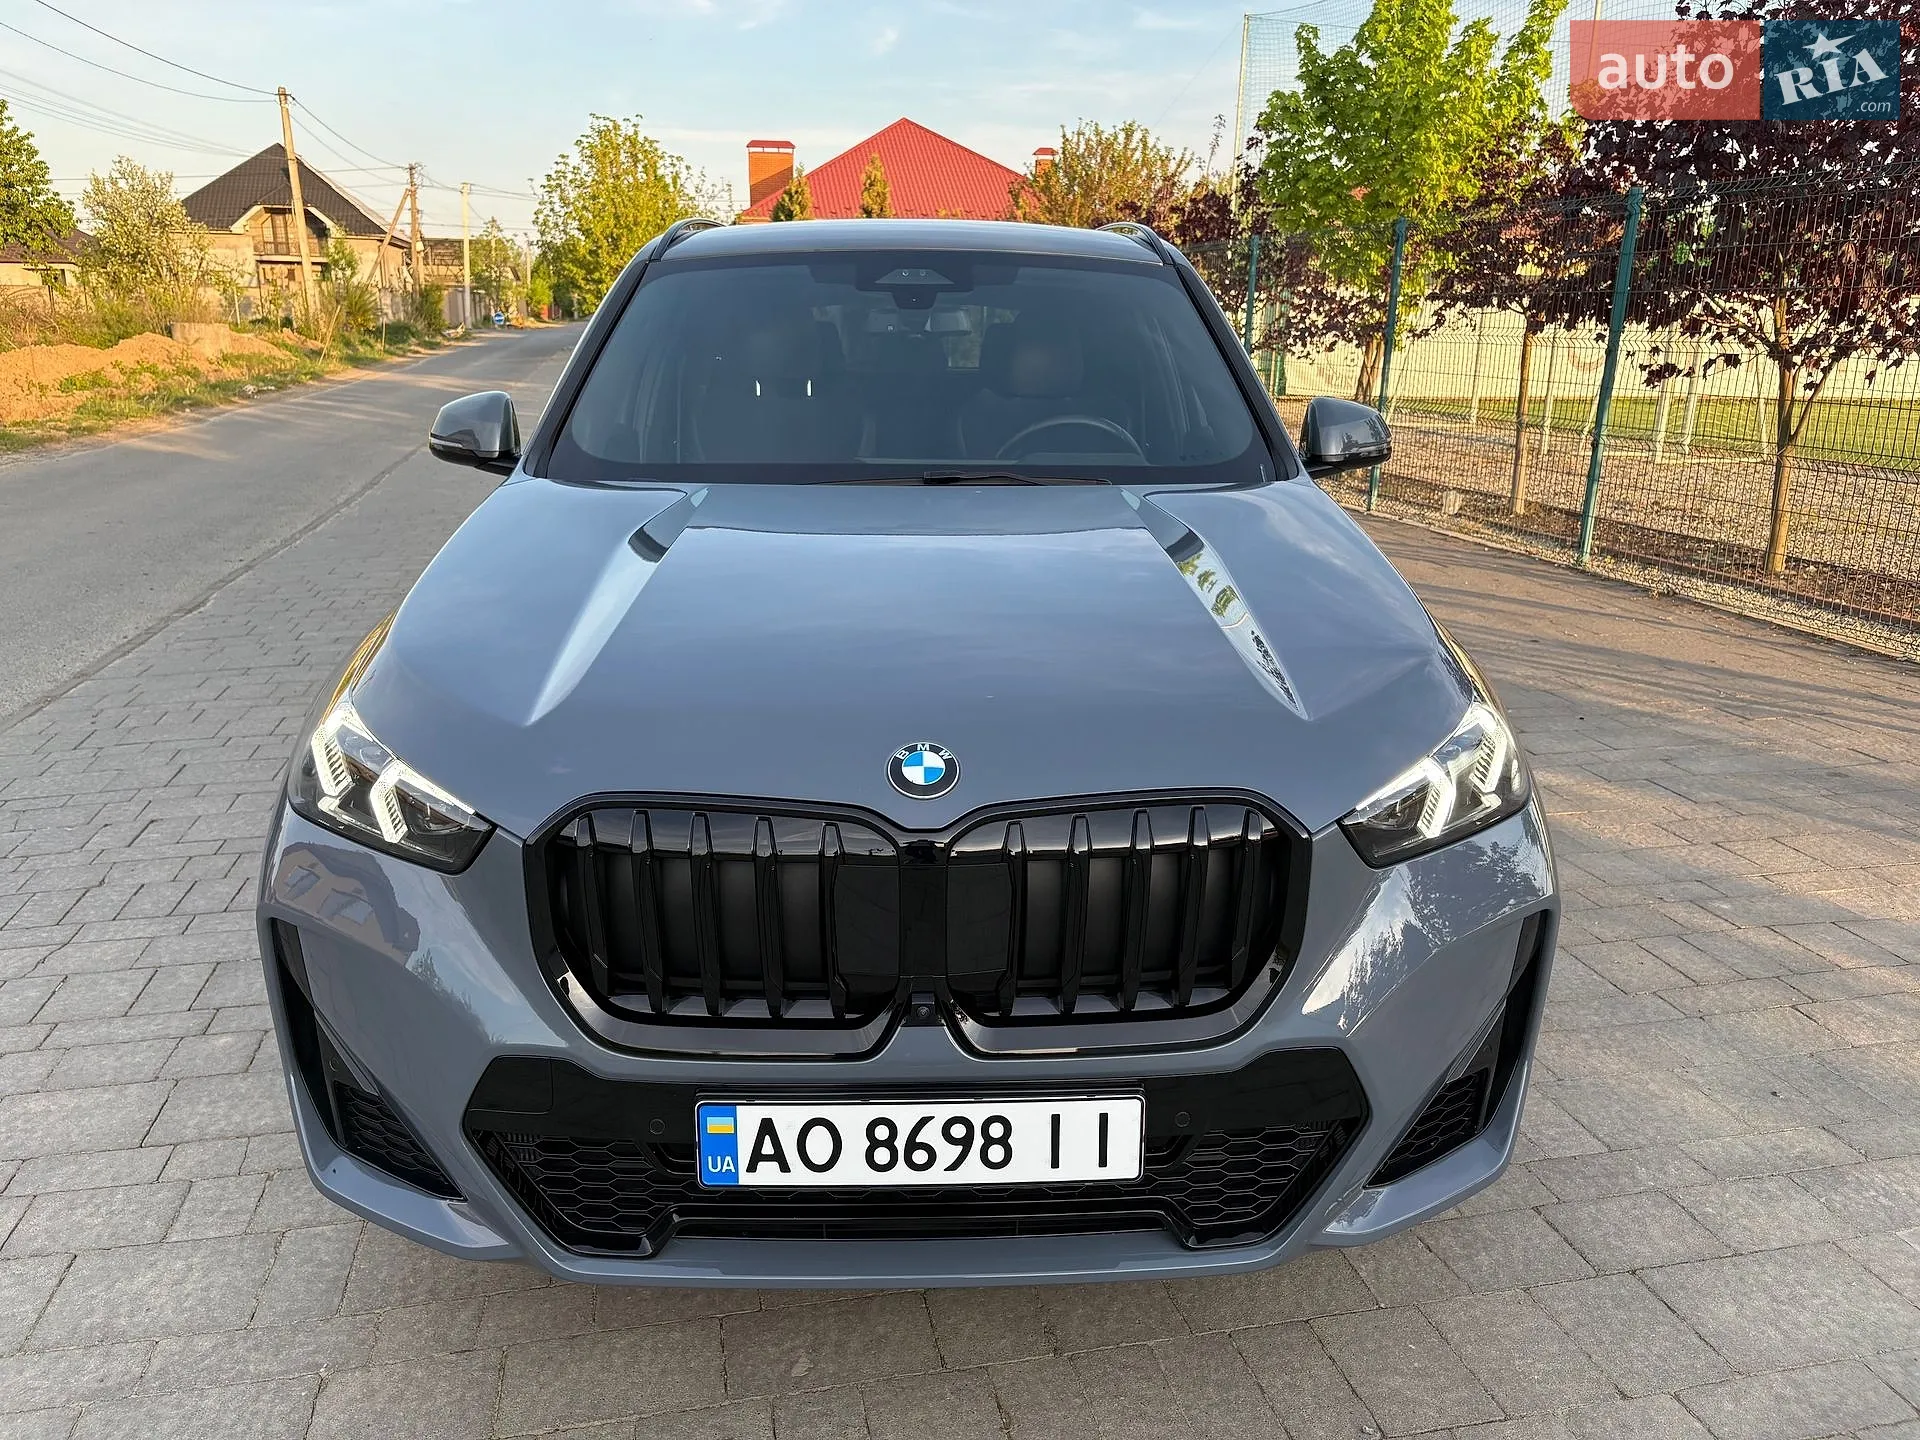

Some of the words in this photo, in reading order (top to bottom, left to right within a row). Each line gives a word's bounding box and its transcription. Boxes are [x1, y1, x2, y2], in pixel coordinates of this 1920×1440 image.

[896, 743, 953, 760] BMW
[746, 1117, 842, 1173] AO
[865, 1115, 1013, 1172] 8698
[708, 1155, 736, 1173] UA
